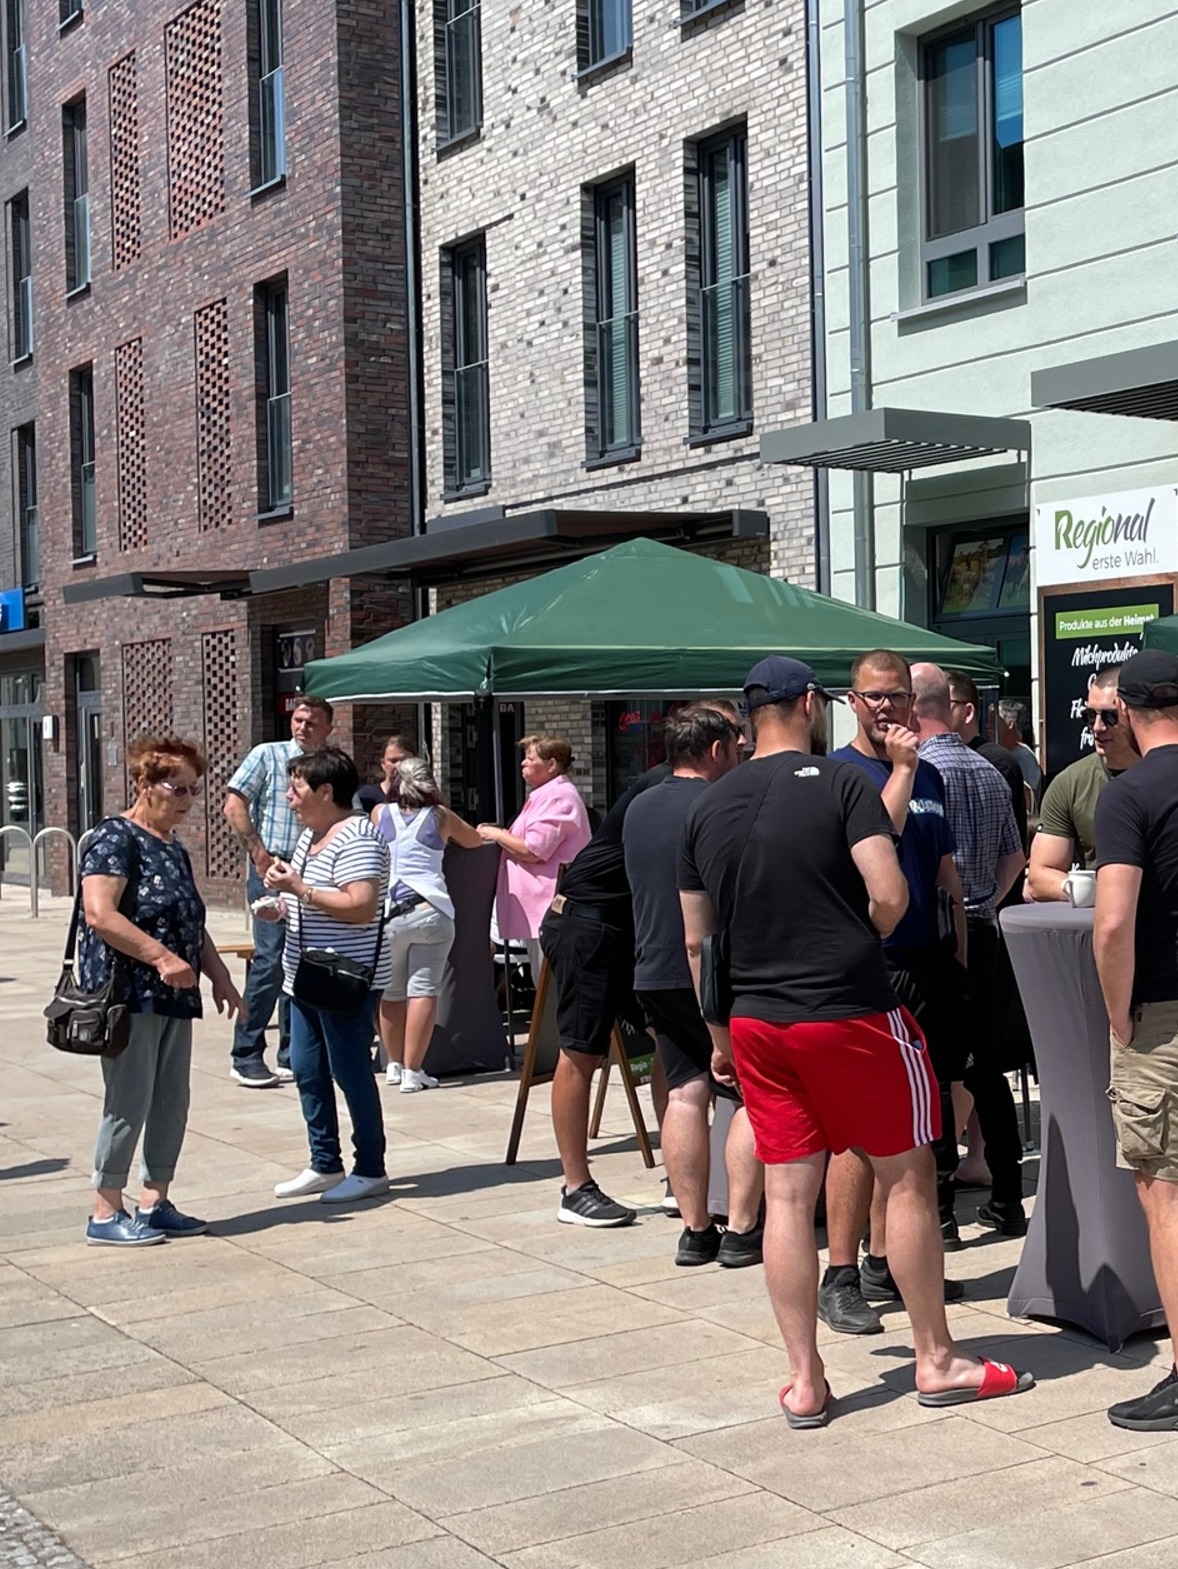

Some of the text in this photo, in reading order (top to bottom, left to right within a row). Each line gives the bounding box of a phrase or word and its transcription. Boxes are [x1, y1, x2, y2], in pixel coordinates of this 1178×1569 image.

[1054, 498, 1155, 569] Regional
[1092, 547, 1159, 570] erste Wahl.
[1059, 618, 1093, 631] Produkte
[1094, 619, 1108, 629] aus
[1109, 617, 1122, 628] der
